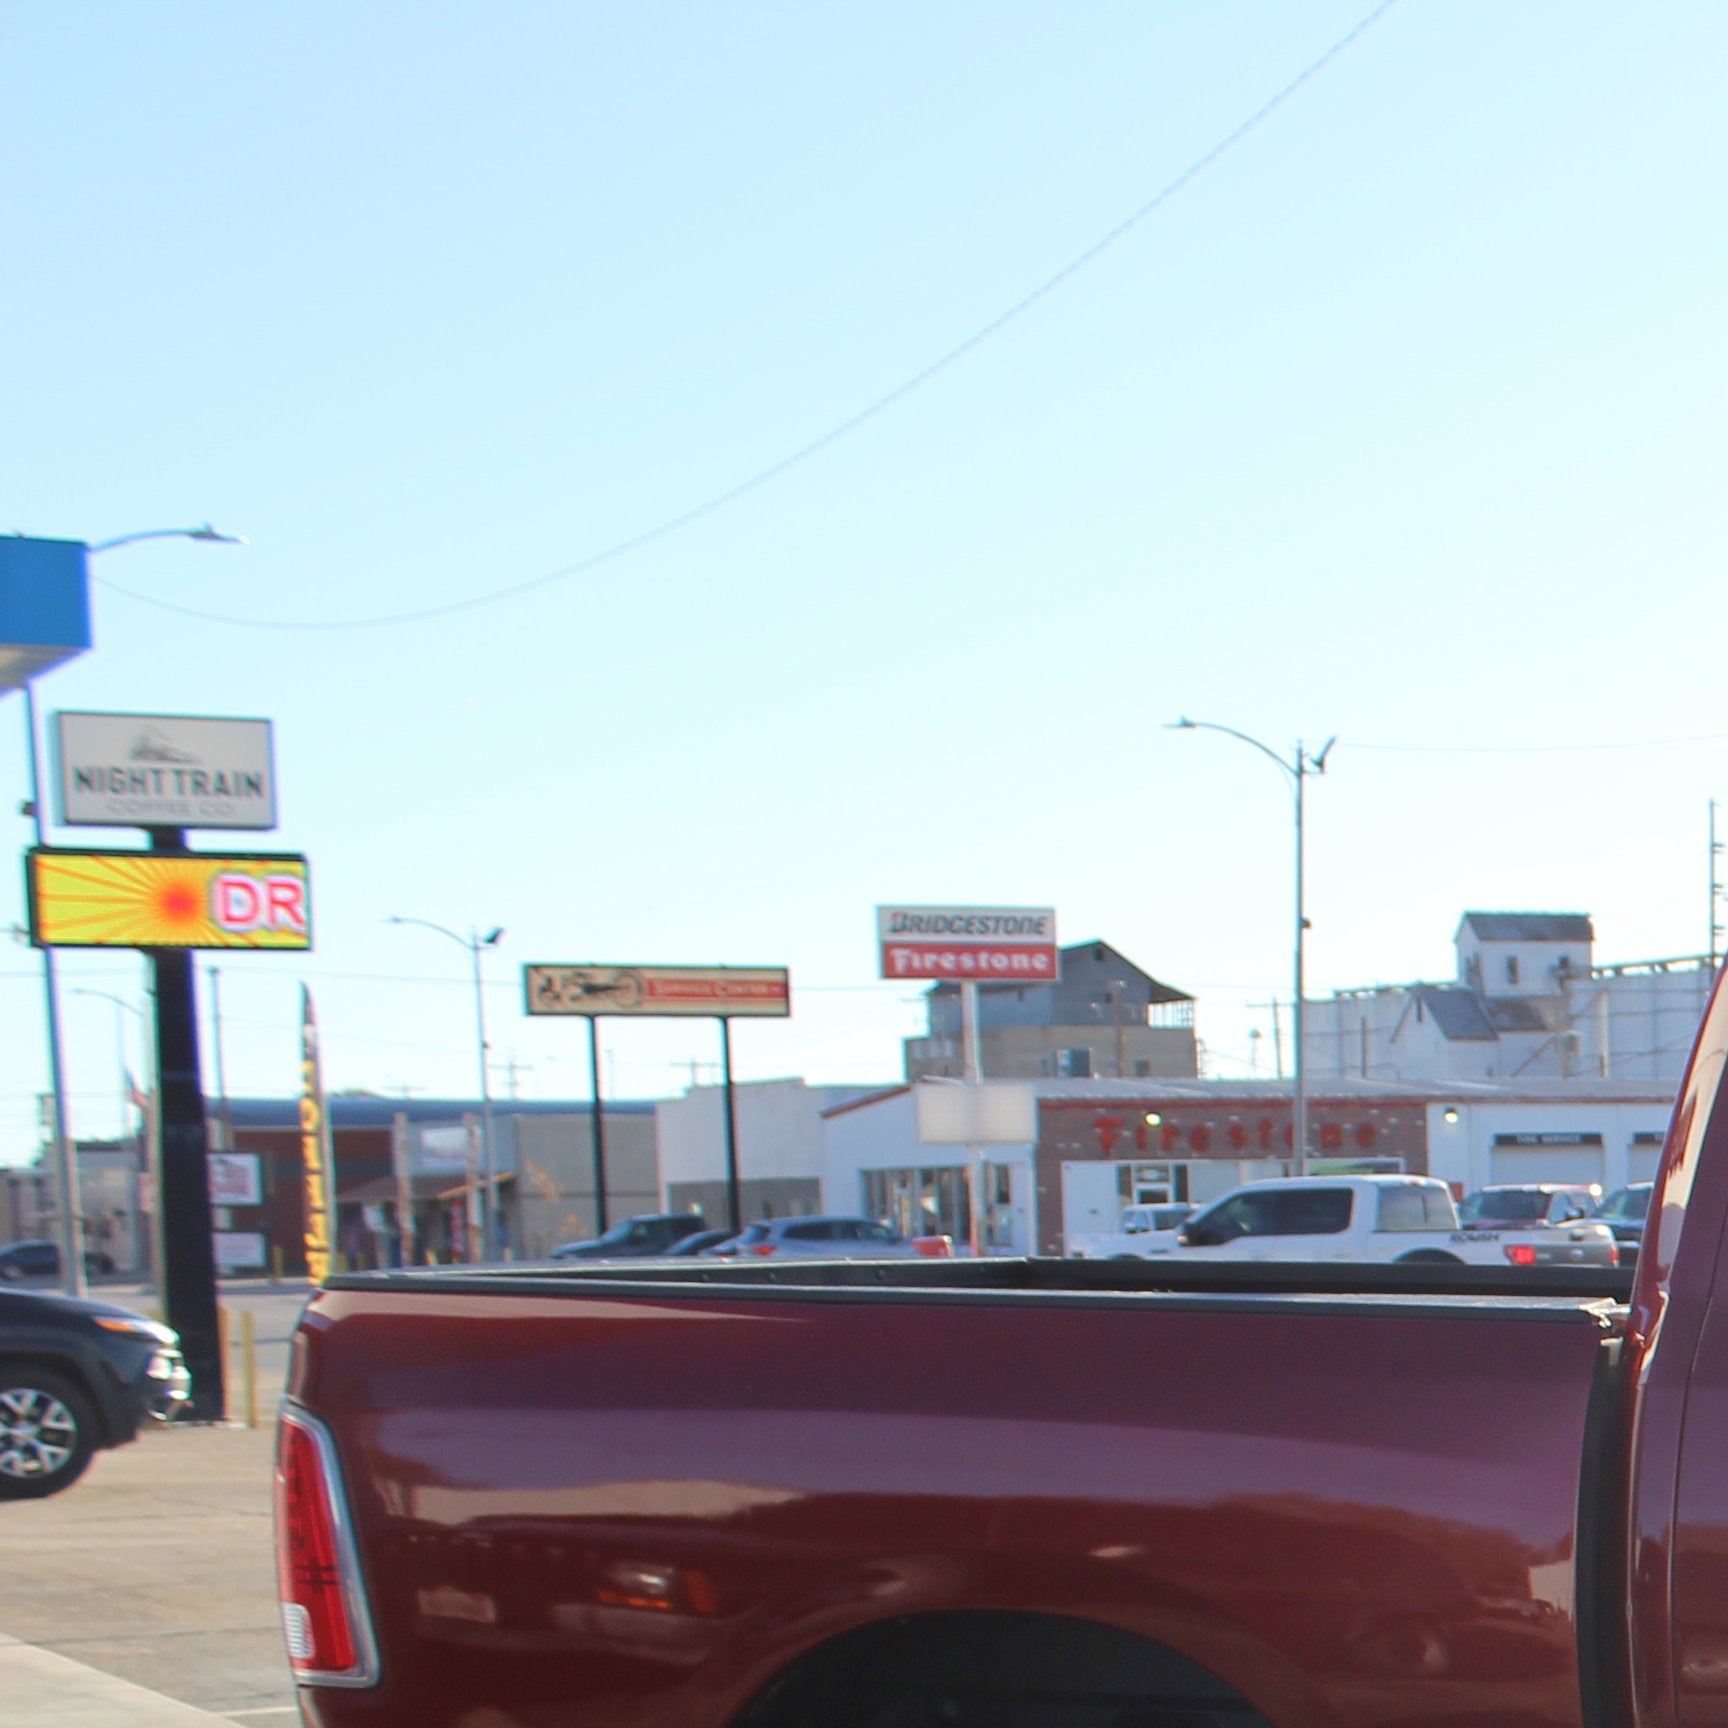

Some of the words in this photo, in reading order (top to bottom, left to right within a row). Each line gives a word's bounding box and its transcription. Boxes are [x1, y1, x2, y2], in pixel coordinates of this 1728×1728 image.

[74, 766, 167, 795] NIGHT
[173, 768, 264, 797] TRAIN
[216, 874, 306, 929] DR
[889, 912, 1047, 934] BRIDGESTONE
[891, 948, 1049, 975] Firestone
